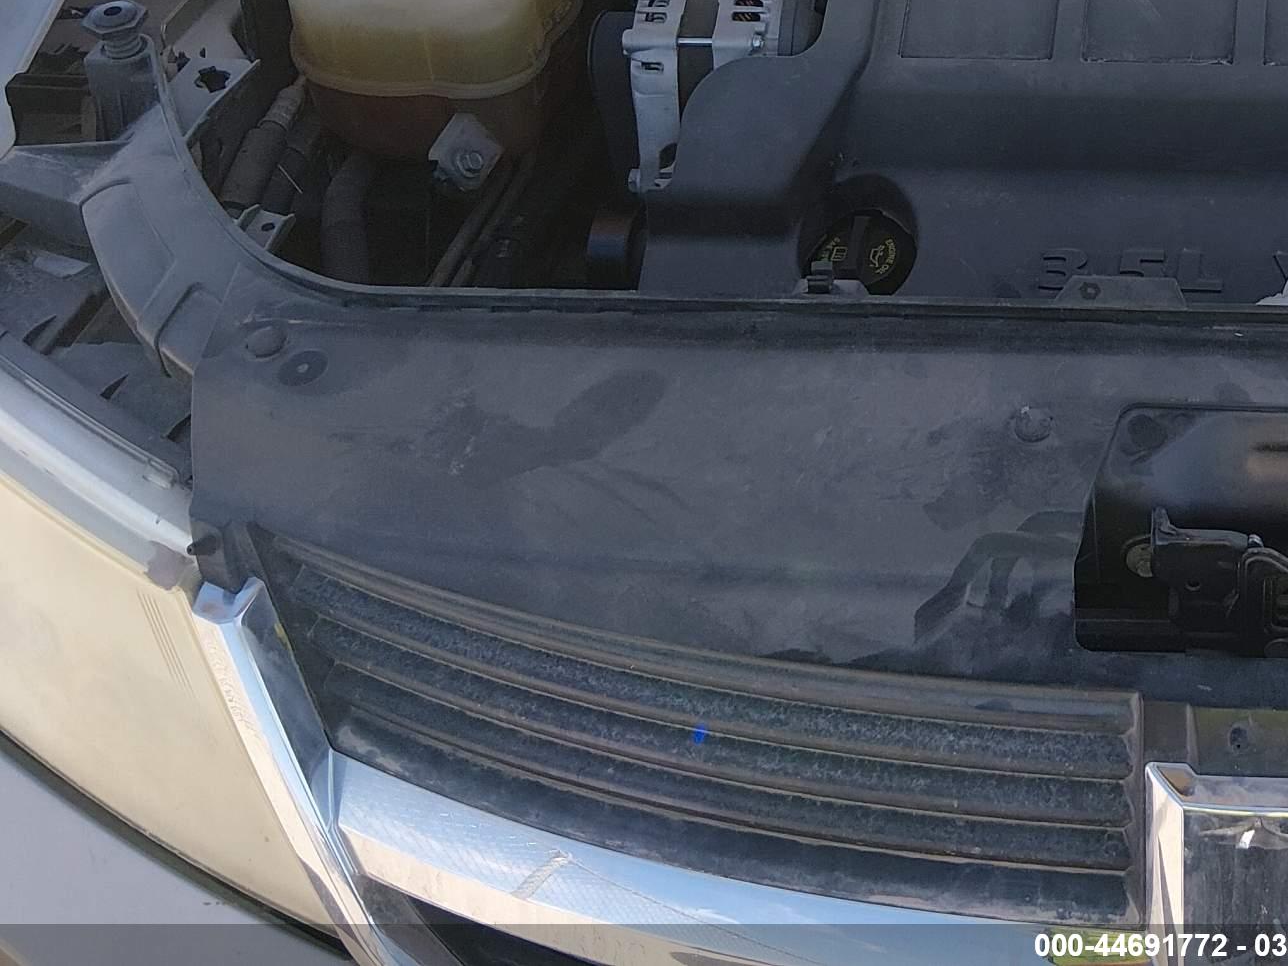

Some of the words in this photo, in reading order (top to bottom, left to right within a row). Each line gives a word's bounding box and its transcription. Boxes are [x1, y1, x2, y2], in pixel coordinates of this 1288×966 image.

[884, 238, 897, 265] ENGINE
[874, 264, 890, 275] OIL
[1038, 247, 1224, 293] 35L
